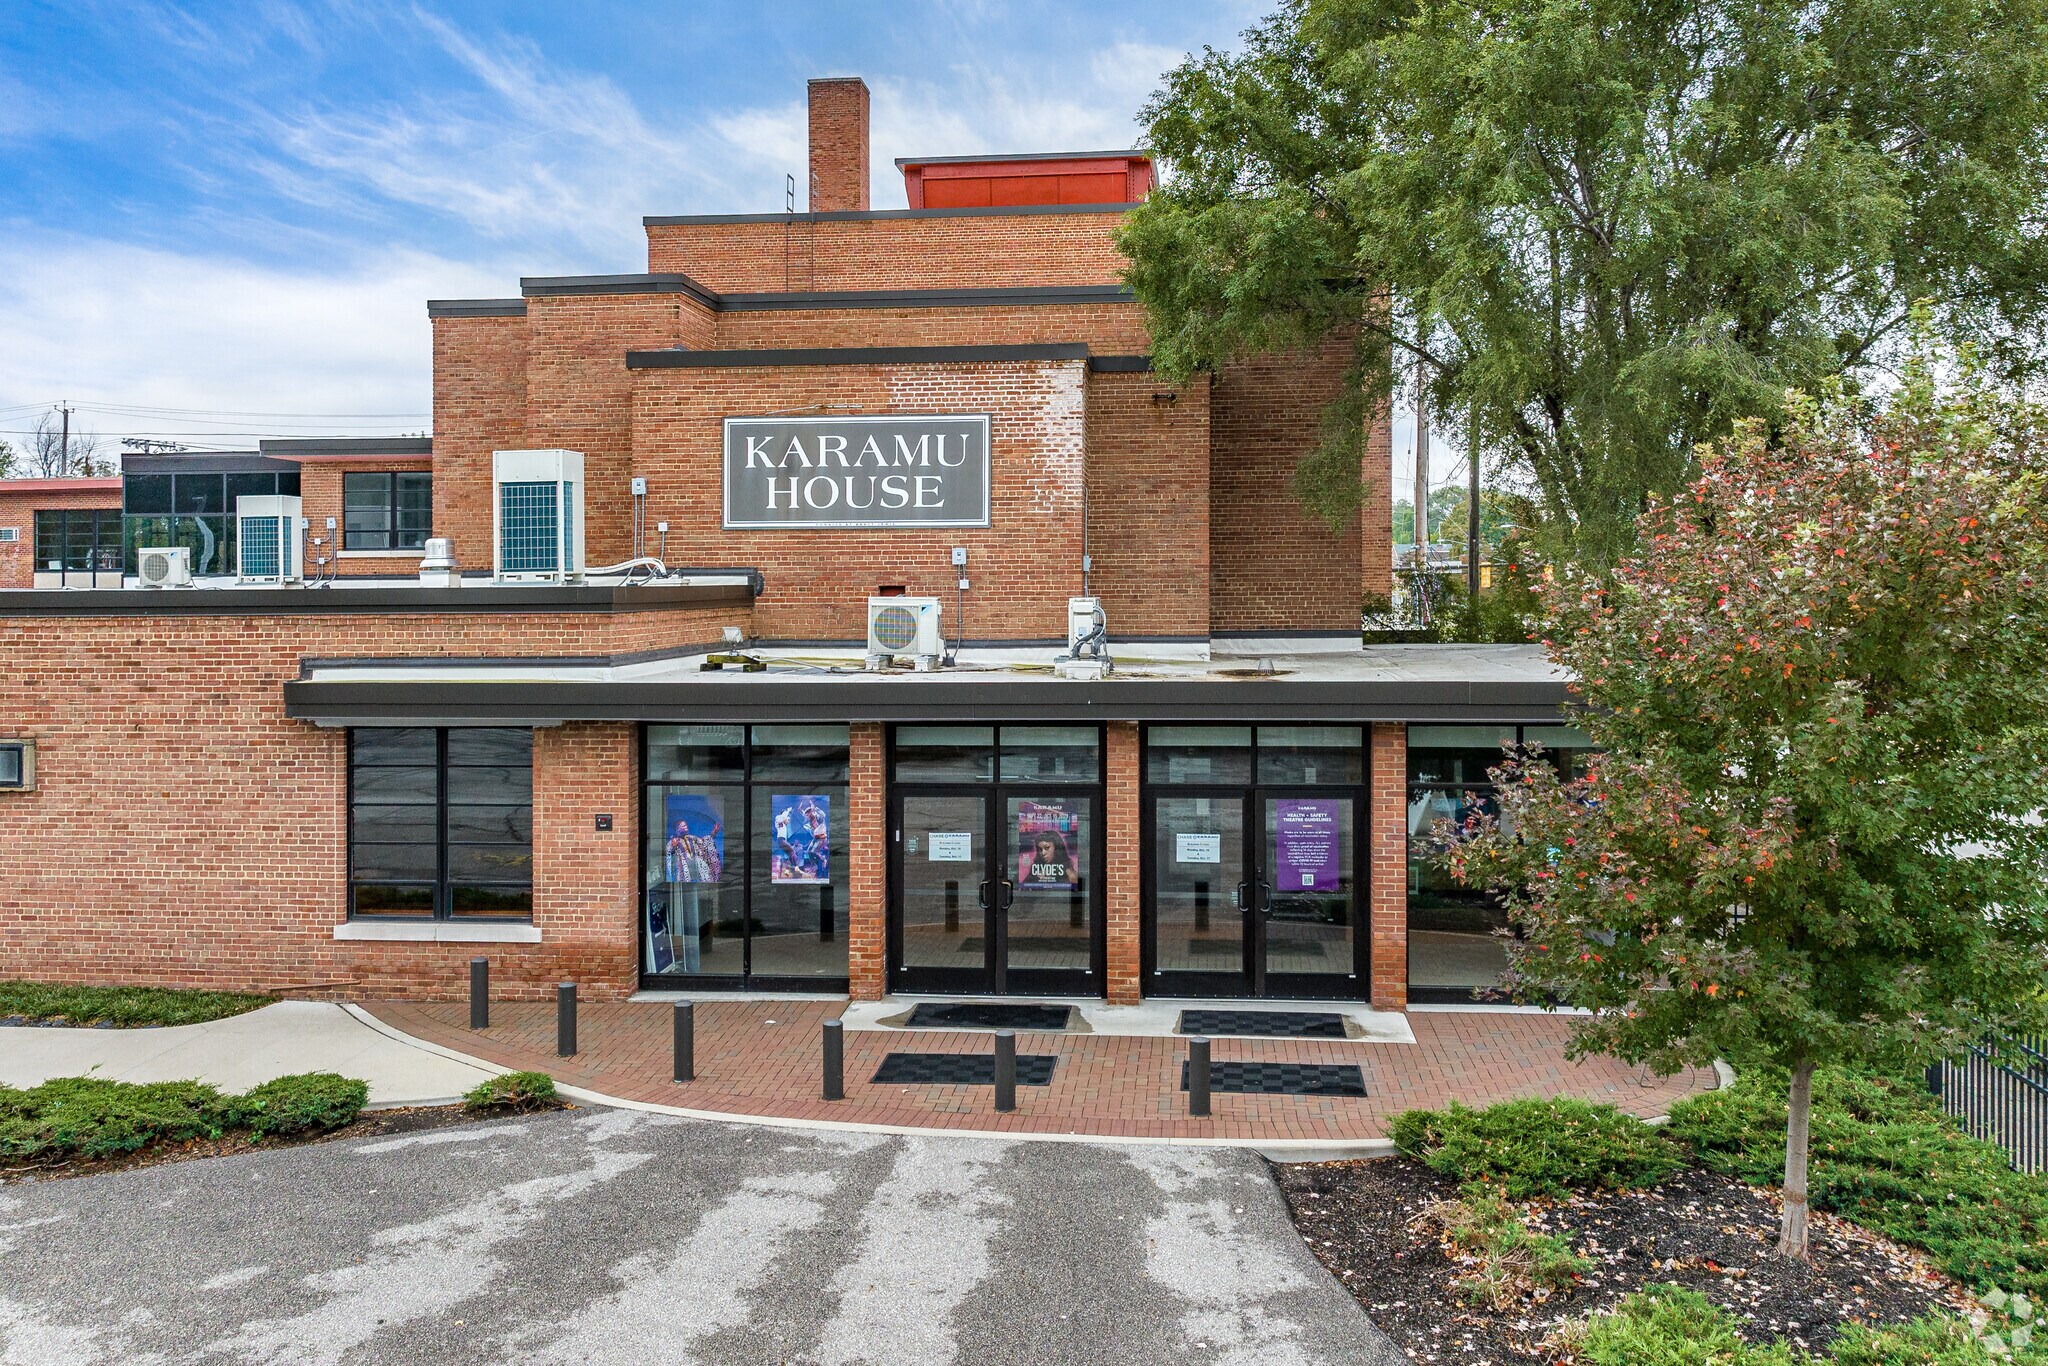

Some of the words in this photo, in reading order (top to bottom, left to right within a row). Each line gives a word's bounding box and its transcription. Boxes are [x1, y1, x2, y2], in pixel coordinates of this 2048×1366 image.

[745, 434, 969, 468] KARAMU
[765, 475, 945, 509] HOUSE
[1031, 863, 1064, 876] CLYDE'S
